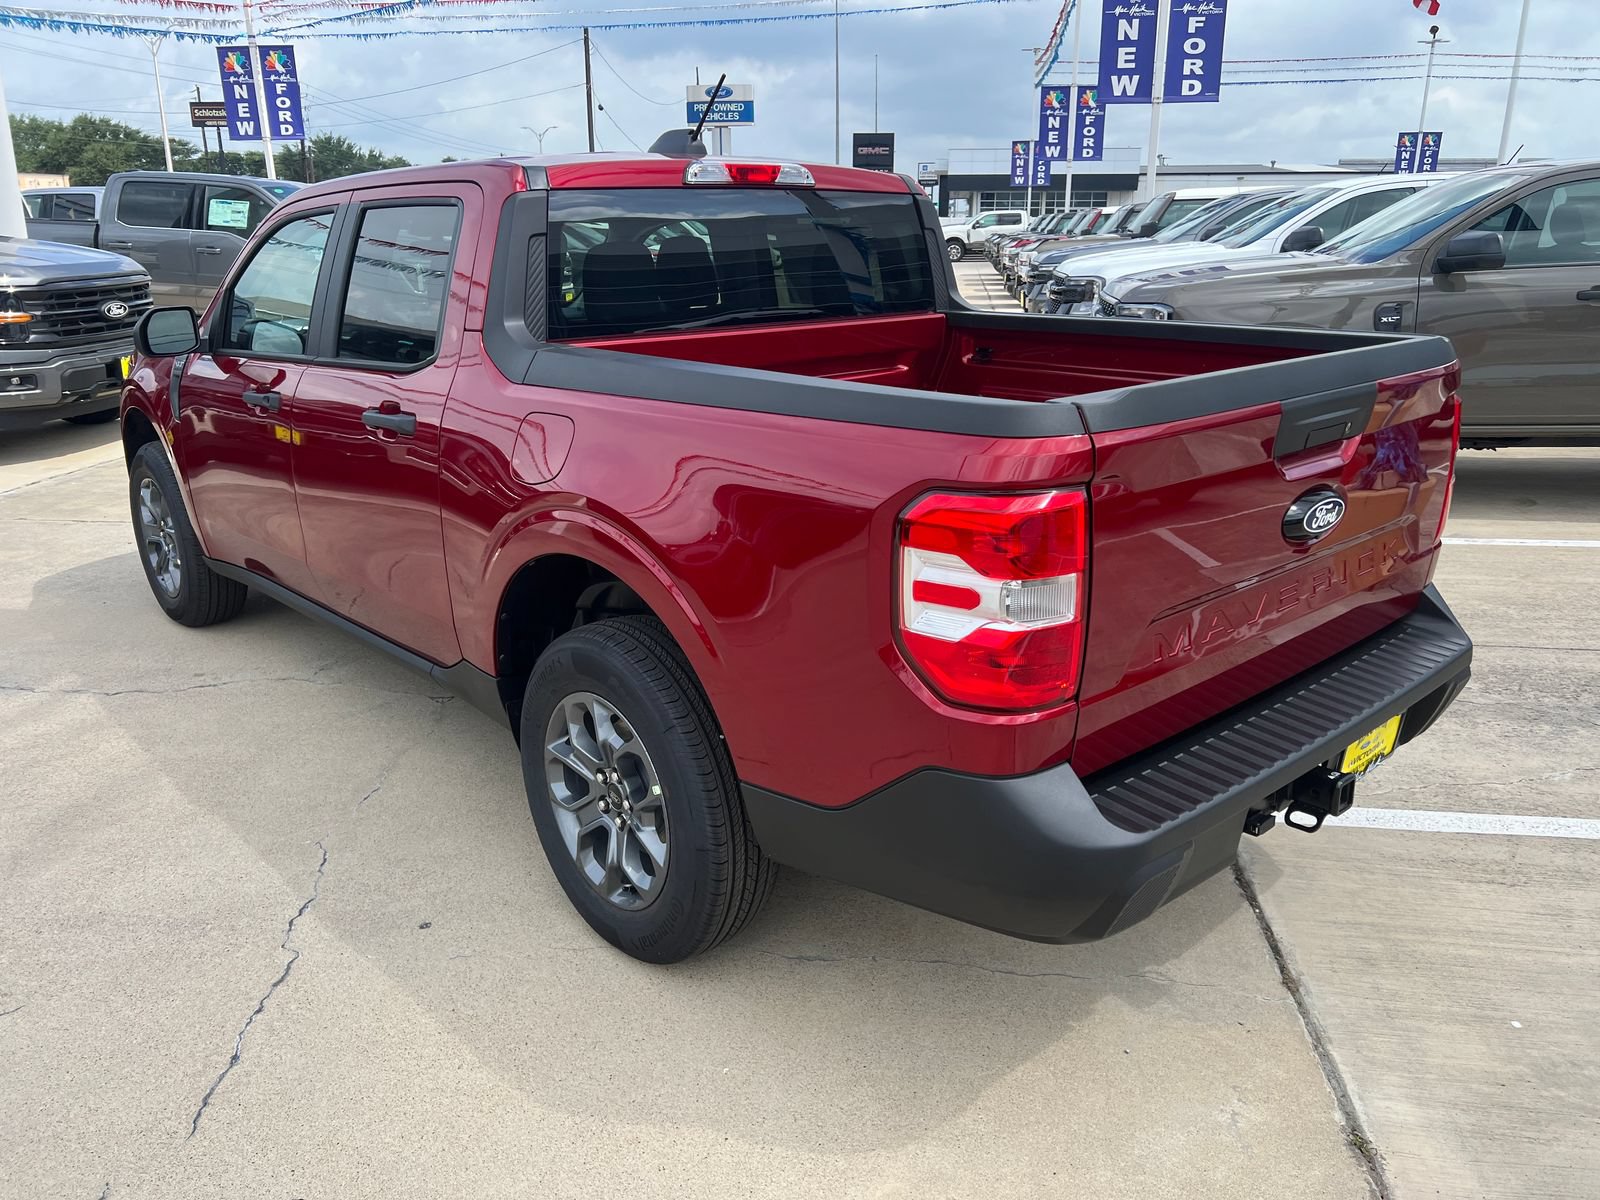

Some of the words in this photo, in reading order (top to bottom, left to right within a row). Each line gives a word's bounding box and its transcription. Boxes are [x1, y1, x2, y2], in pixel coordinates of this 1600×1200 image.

[1110, 18, 1140, 97] NEW
[1181, 16, 1207, 96] FORD
[233, 84, 254, 136] NEW
[275, 83, 294, 136] FORD
[857, 147, 890, 155] GMC
[1045, 116, 1061, 158] NEW
[1082, 115, 1096, 158] FORD
[1014, 158, 1025, 185] NEW
[110, 304, 125, 315] Ford
[1312, 503, 1340, 529] Ford
[1152, 536, 1402, 665] MAVERICK
